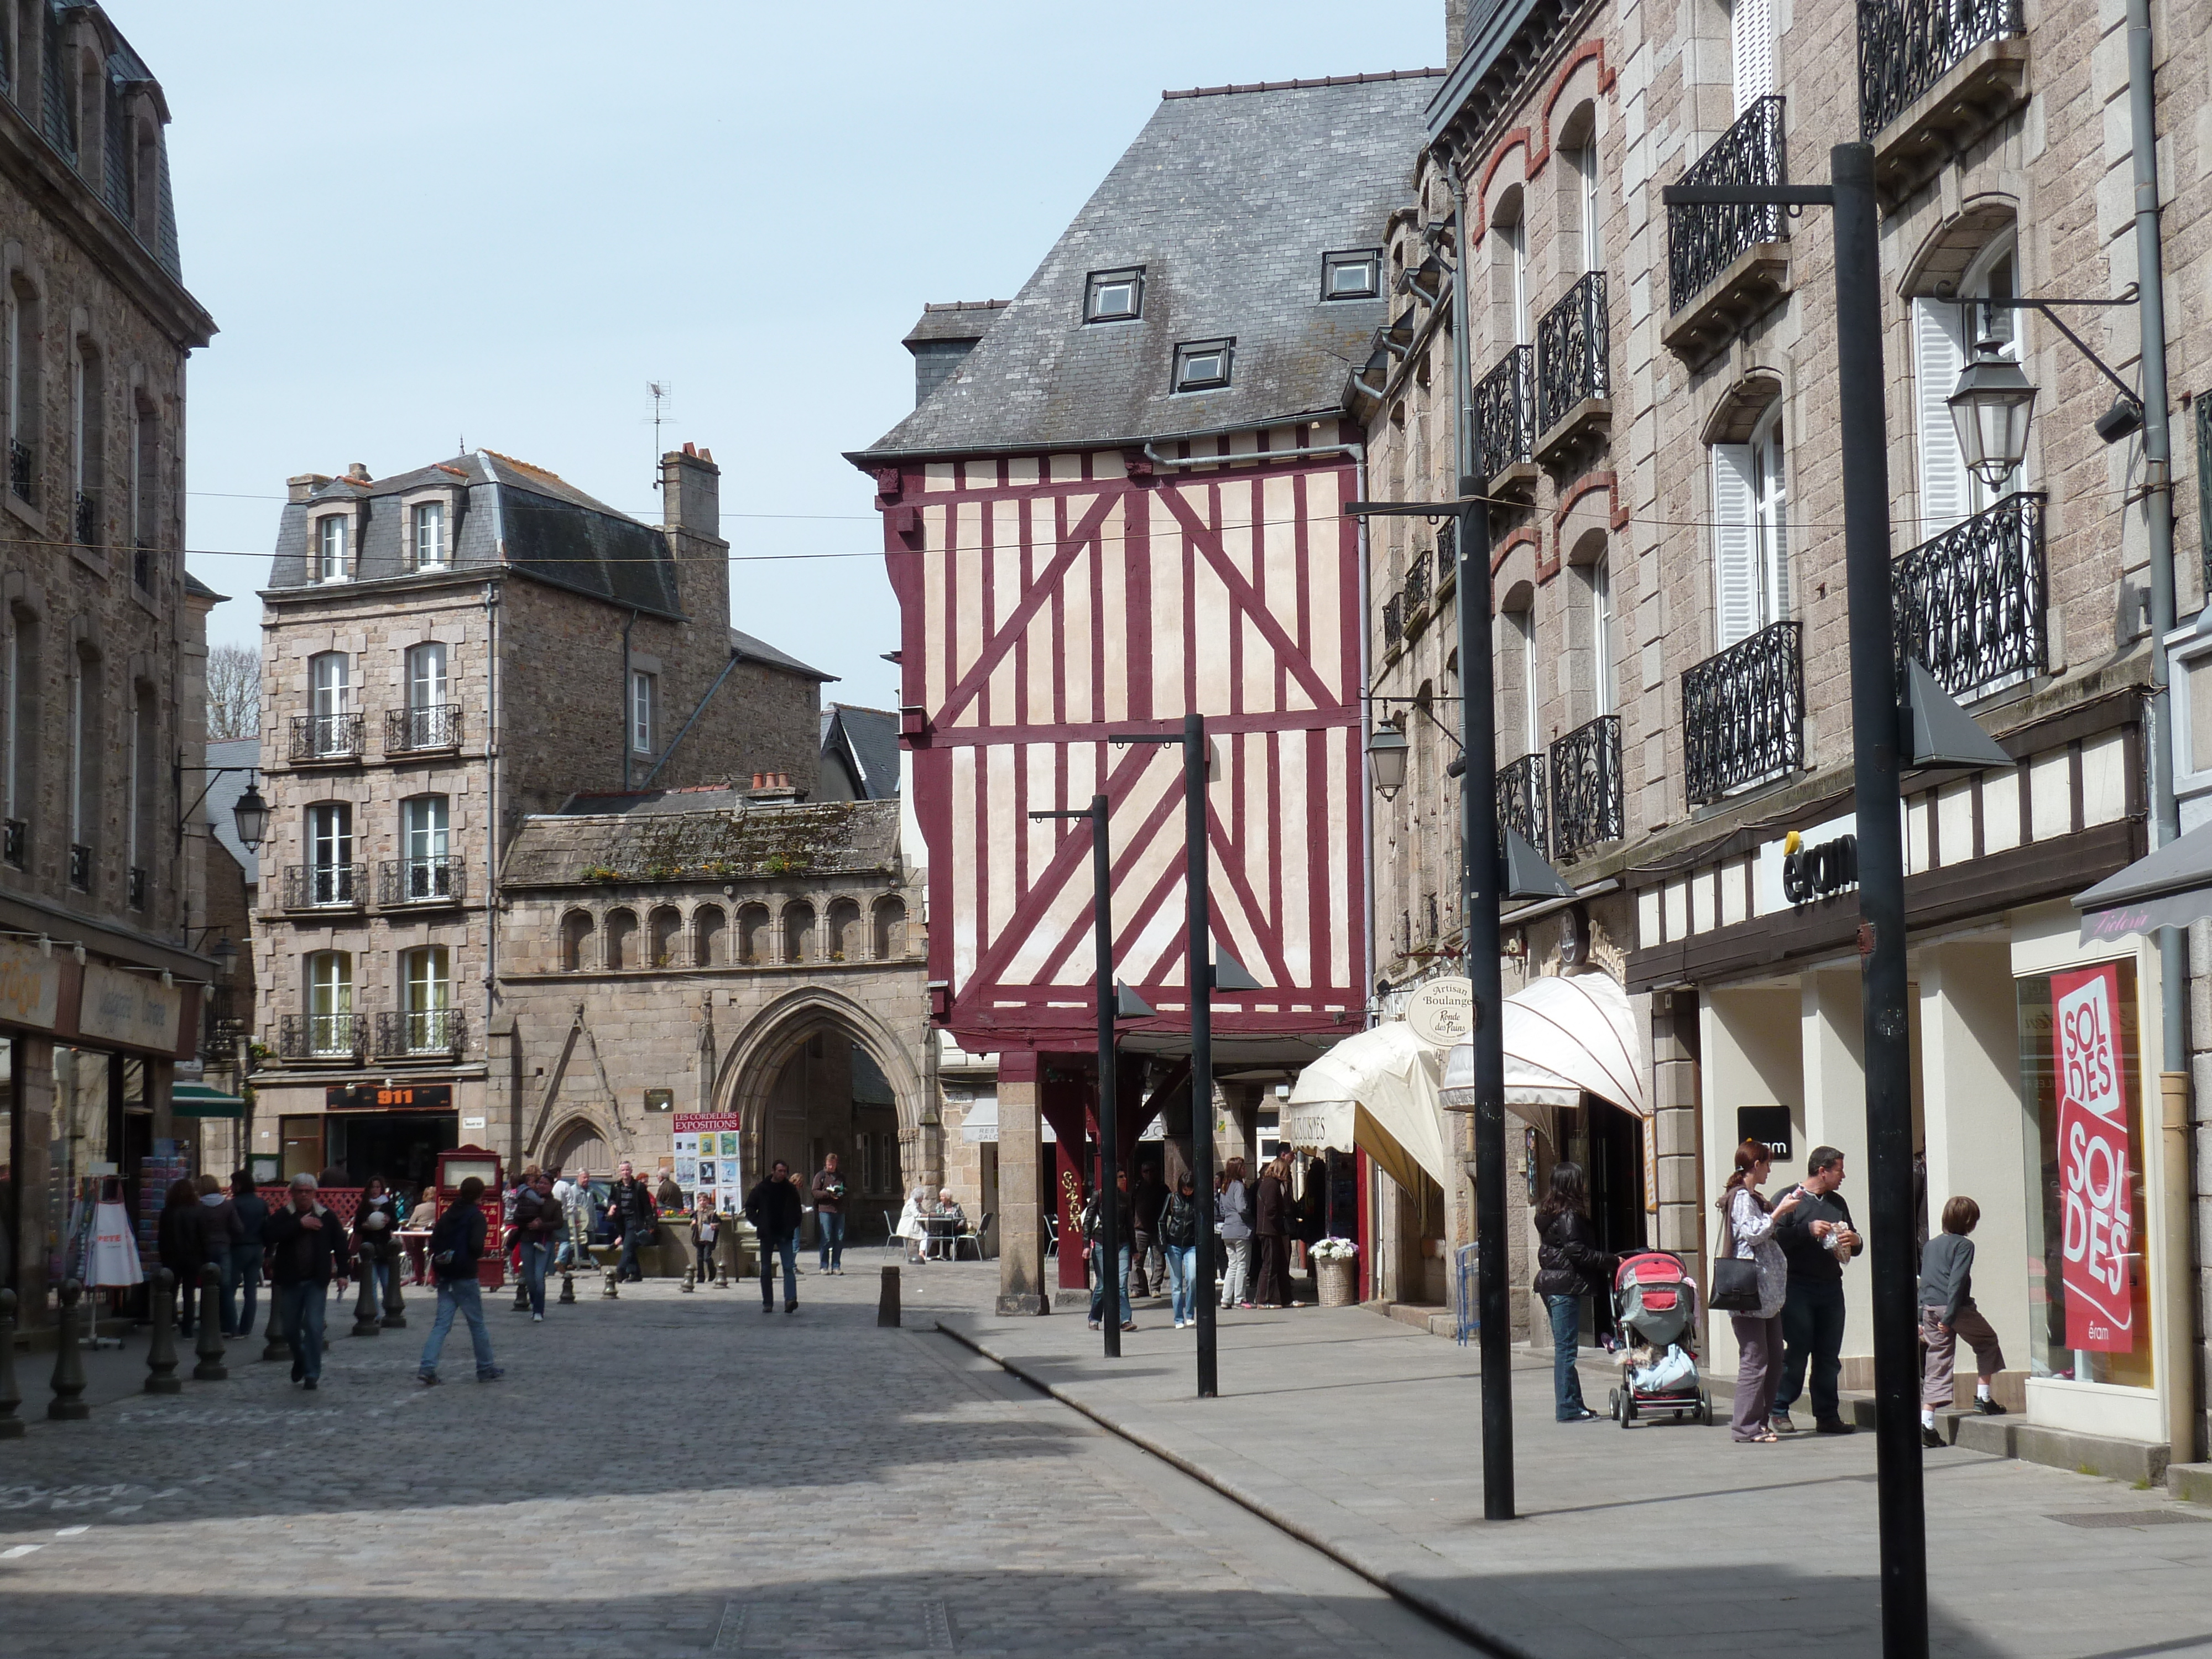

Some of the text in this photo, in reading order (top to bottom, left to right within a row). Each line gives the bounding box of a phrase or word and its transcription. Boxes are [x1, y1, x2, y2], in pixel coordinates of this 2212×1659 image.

[2093, 907, 2150, 936] Victoria
[1433, 985, 1467, 995] Artisan
[1423, 995, 1472, 1008] Boulange
[1439, 1010, 1460, 1021] Ronde
[1435, 1021, 1465, 1034] des Pains
[2064, 997, 2106, 1060] SOL
[2069, 1045, 2111, 1102] DES
[377, 1089, 413, 1104] 911
[690, 1112, 737, 1120] CORDELIERS
[675, 1120, 737, 1130] EXPOSITIONS
[2067, 1121, 2130, 1225] SOL
[2064, 1189, 2128, 1295] DES
[2088, 1320, 2109, 1340] éram
